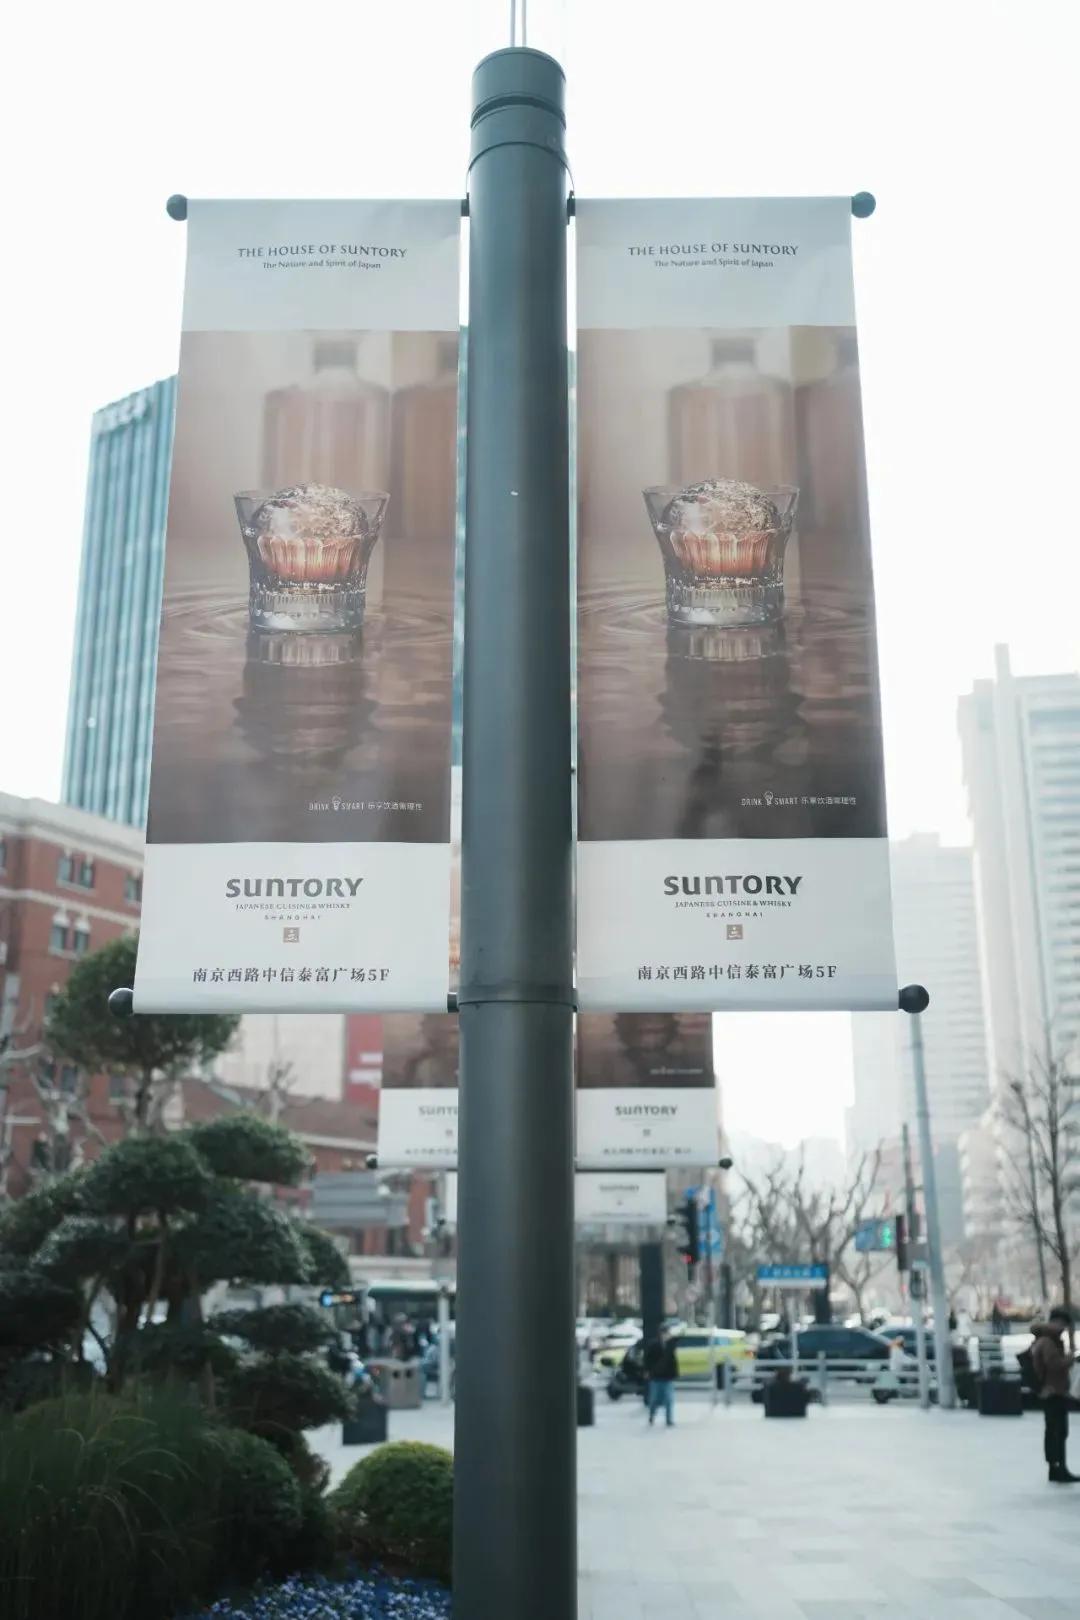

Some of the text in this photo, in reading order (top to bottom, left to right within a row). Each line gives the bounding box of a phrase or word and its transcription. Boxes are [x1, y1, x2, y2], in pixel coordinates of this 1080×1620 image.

[238, 244, 408, 258] THE HOUSE OF SUNTORY
[628, 243, 799, 256] THE HOUSE OF SUNTORY
[263, 261, 277, 269] The
[278, 260, 306, 268] Nature
[325, 260, 346, 269] Spirit
[358, 261, 381, 270] Japan
[701, 258, 717, 266] and
[718, 258, 739, 267] Spirit
[741, 258, 750, 266] of
[751, 259, 774, 268] Japan
[774, 796, 798, 806] SMART
[225, 877, 364, 899] SUNTORY
[663, 875, 803, 896] SUNTORY
[192, 967, 390, 983] 南京西路中信泰富广场5F
[637, 964, 837, 981] 南京西路中信泰富广场5F
[615, 1105, 678, 1116] SUNTORY
